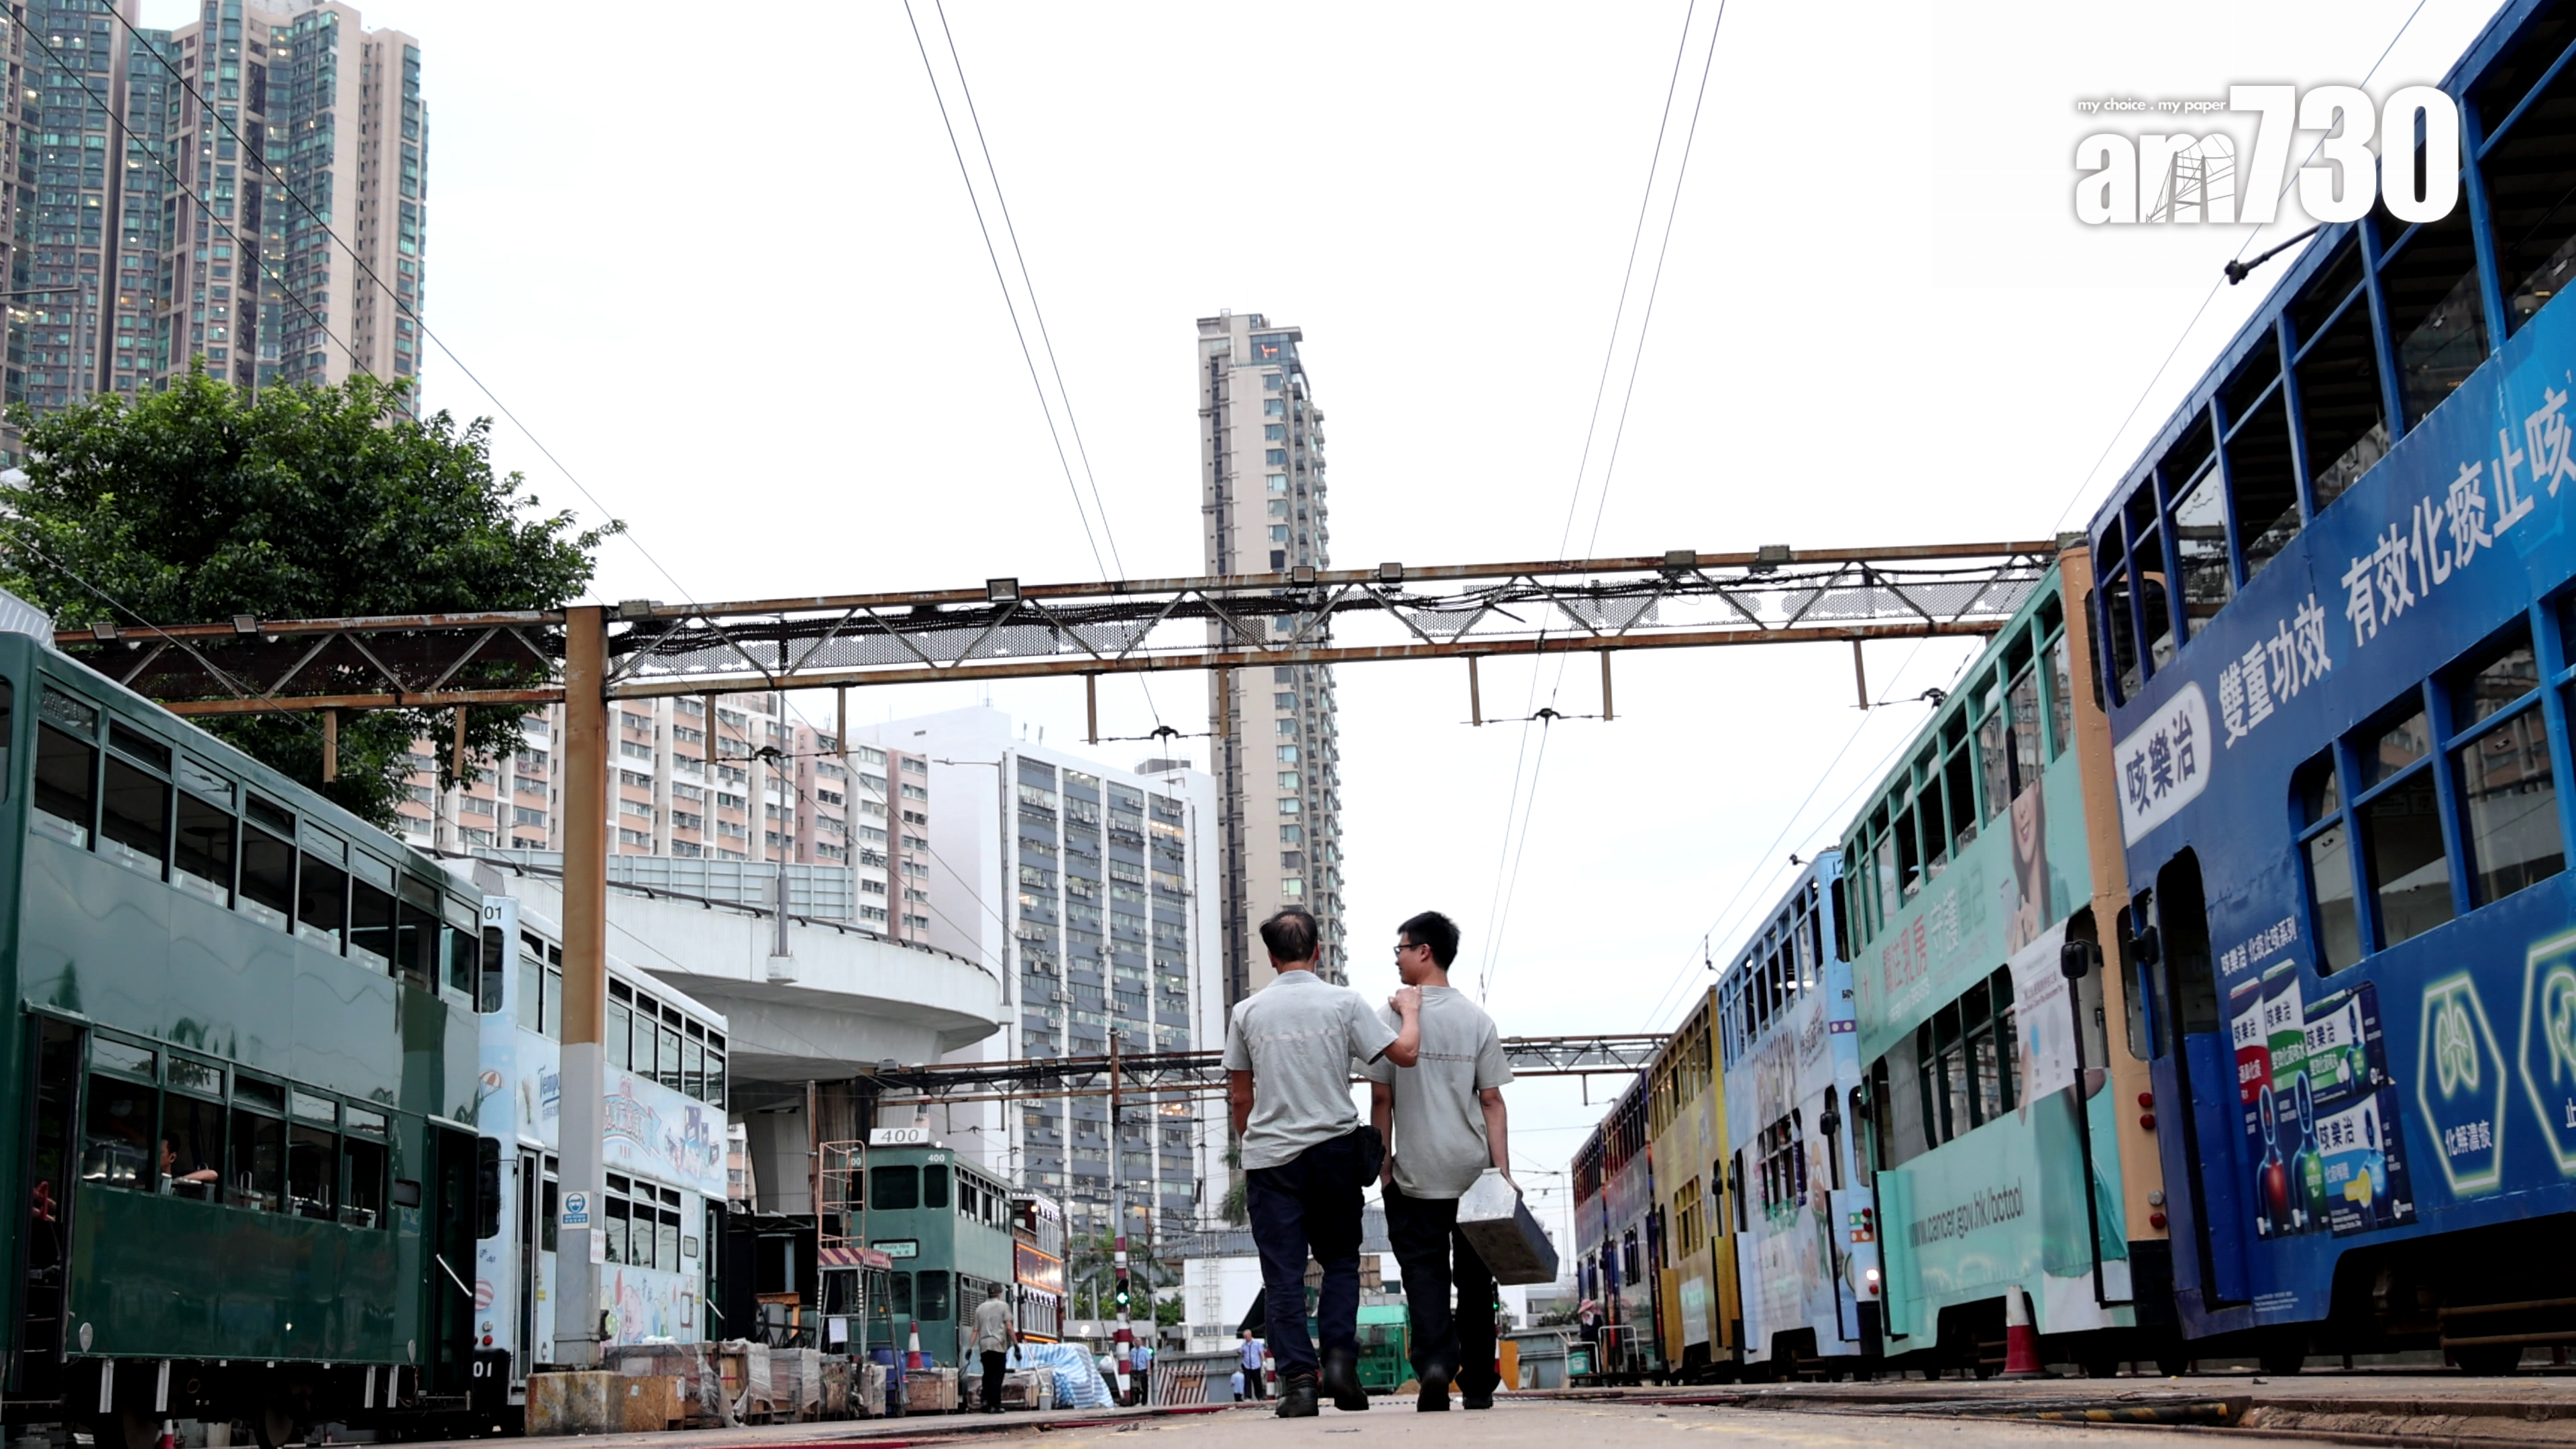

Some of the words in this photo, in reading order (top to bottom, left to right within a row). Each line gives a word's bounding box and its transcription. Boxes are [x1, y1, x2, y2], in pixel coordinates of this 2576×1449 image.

[2218, 593, 2332, 749] 雙重功效
[2341, 386, 2576, 647] 有效化痰止咳
[2126, 710, 2196, 816] 咳樂治
[484, 906, 502, 920] 01
[881, 1129, 919, 1142] 400
[2318, 1115, 2355, 1150] 咳樂治
[927, 1154, 945, 1163] 400
[1908, 1176, 2025, 1250] www.cancer.gov.hk/bctool
[473, 1361, 492, 1377] 01
